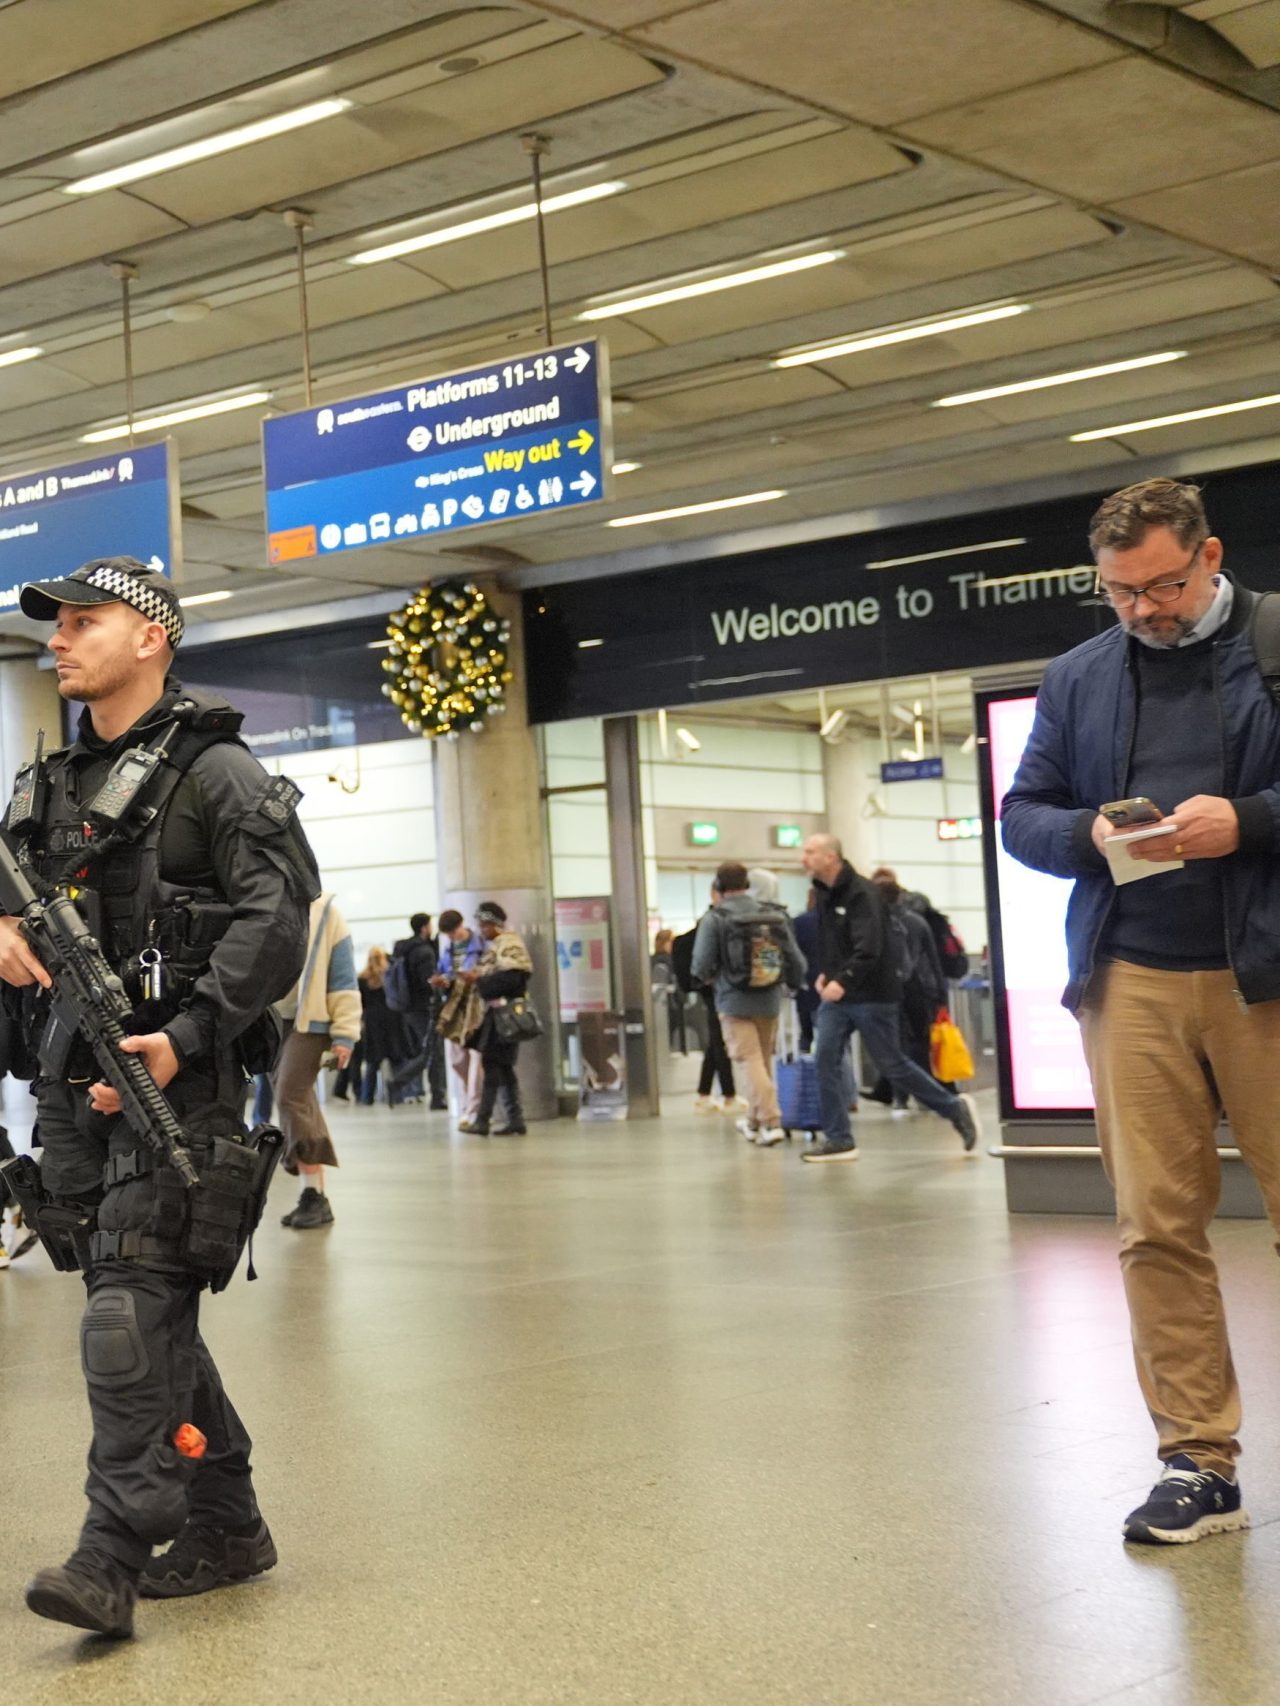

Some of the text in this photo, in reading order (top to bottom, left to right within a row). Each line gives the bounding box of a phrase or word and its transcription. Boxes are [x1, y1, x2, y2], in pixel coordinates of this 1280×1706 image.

[407, 374, 499, 412] Platforms
[502, 356, 558, 389] 11-13
[435, 396, 560, 445] Underground
[483, 449, 525, 473] Way
[528, 438, 561, 464] out
[3, 486, 16, 507] A
[16, 479, 44, 503] and
[45, 476, 59, 497] B
[711, 564, 1095, 646] Welcome to Thame
